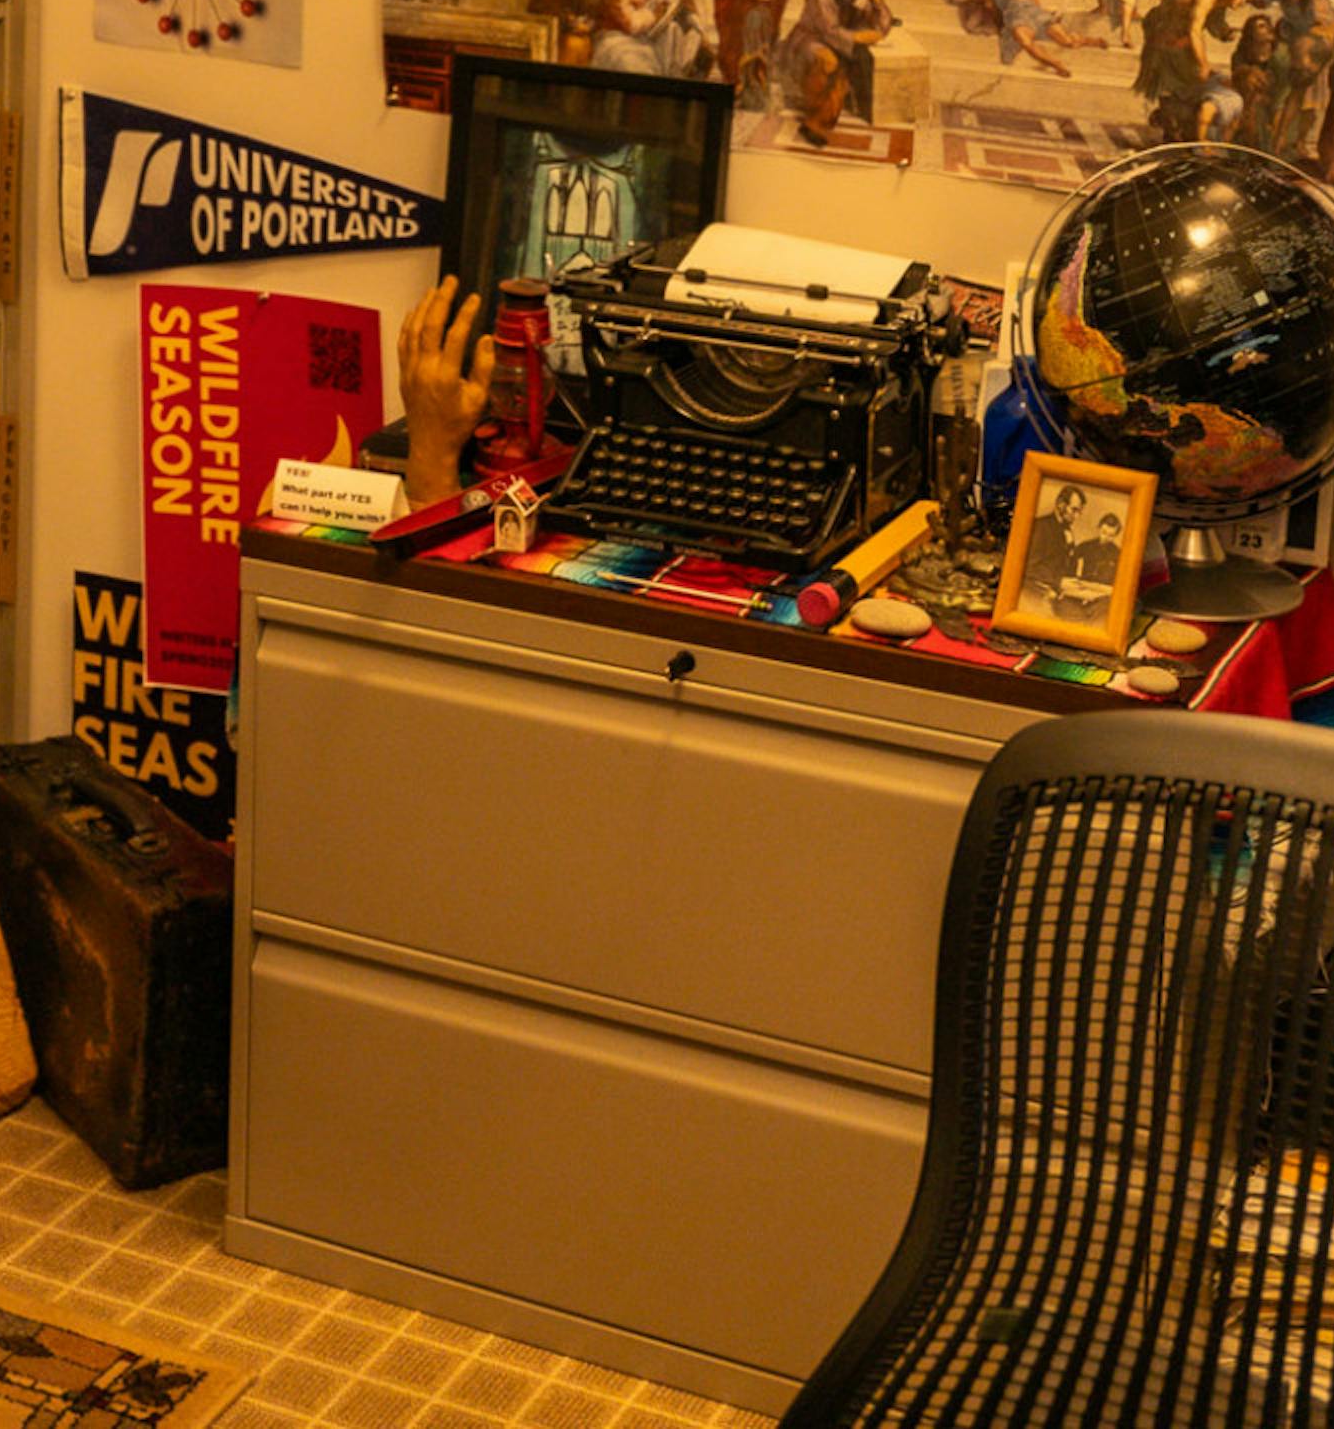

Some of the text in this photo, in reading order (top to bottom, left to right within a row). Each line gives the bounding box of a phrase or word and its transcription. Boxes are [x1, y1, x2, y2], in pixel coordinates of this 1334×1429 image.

[190, 133, 419, 217] UNIVERSITY
[190, 194, 420, 256] OF PORTLAND
[149, 302, 194, 516] SEASON
[197, 304, 241, 546] WILDFIRE
[280, 502, 300, 512] can
[308, 505, 332, 518] help
[334, 510, 354, 520] you
[282, 484, 372, 504] What part of YES
[1240, 533, 1263, 549] 23
[74, 649, 191, 727] FIRE
[75, 715, 218, 798] SEAS
